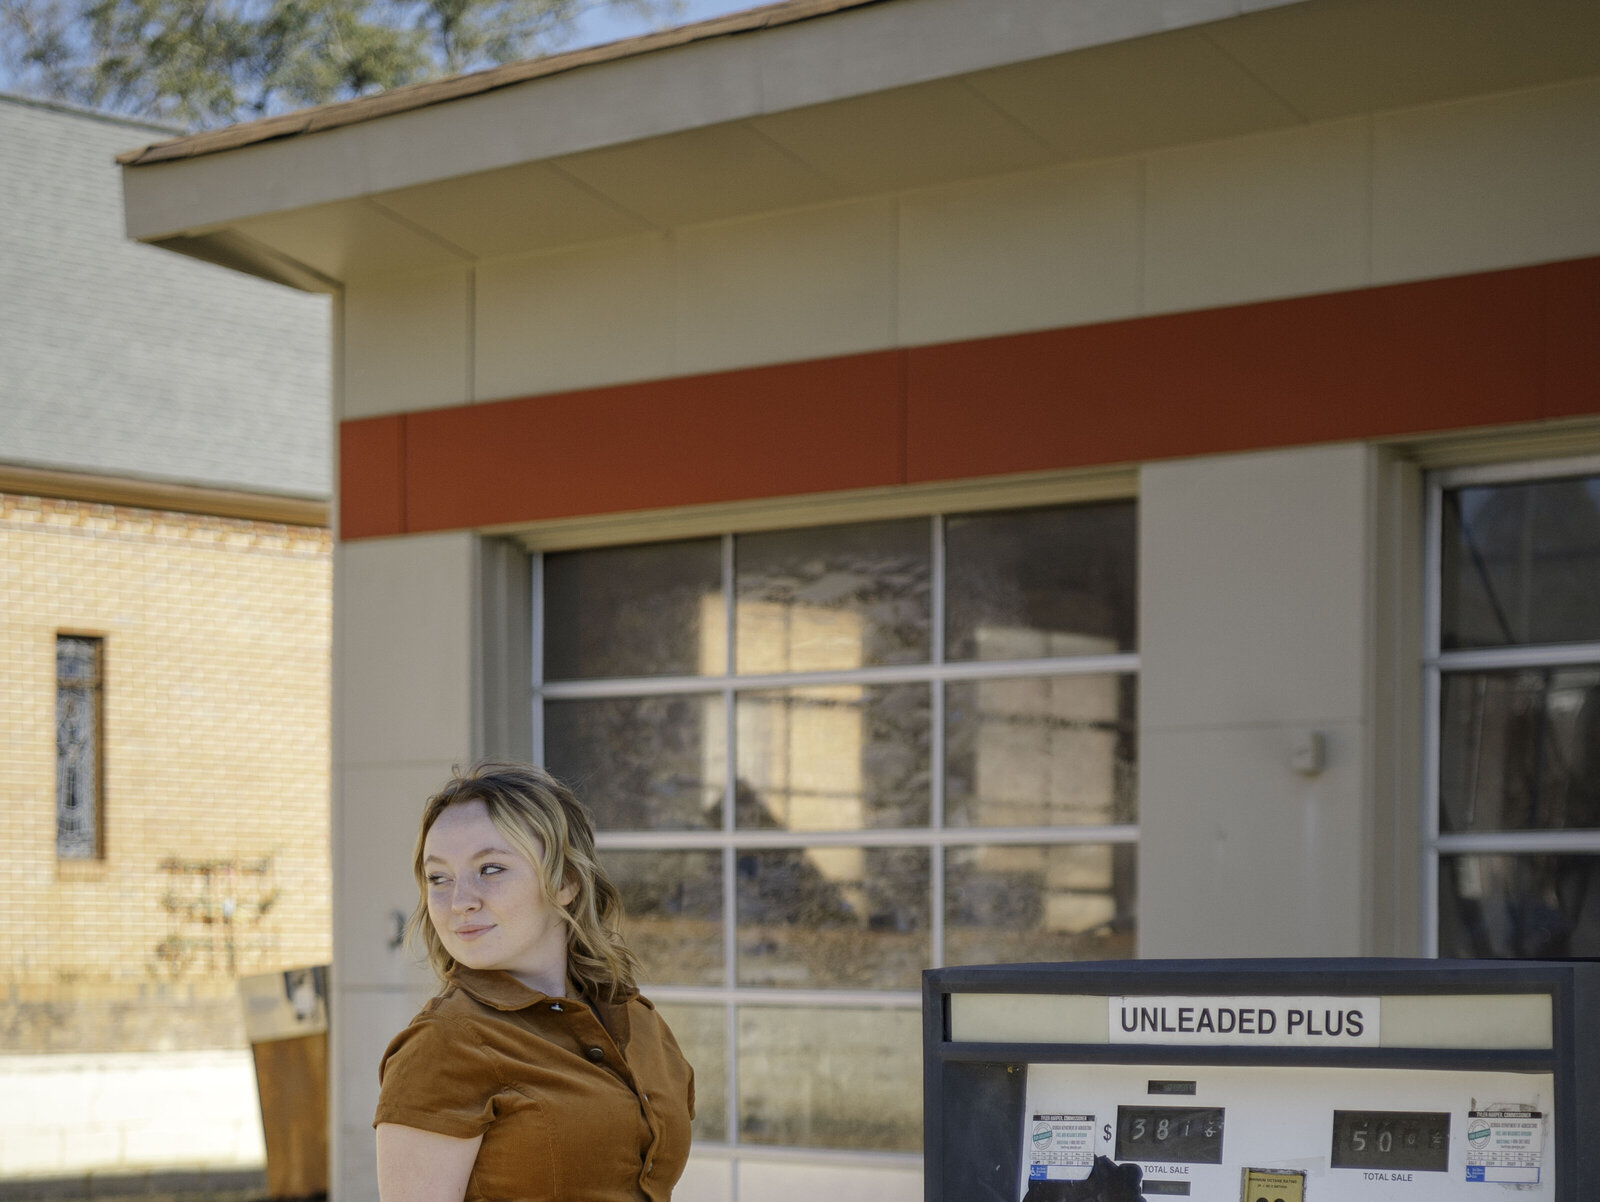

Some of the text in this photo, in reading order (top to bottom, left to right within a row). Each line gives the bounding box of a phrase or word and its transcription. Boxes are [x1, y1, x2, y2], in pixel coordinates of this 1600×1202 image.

[1121, 1006, 1364, 1037] UNLEADED PLUS
[1103, 1123, 1112, 1143] $
[1144, 1165, 1189, 1174] TOTAL SALE
[1363, 1172, 1413, 1182] TOTAL SALE
